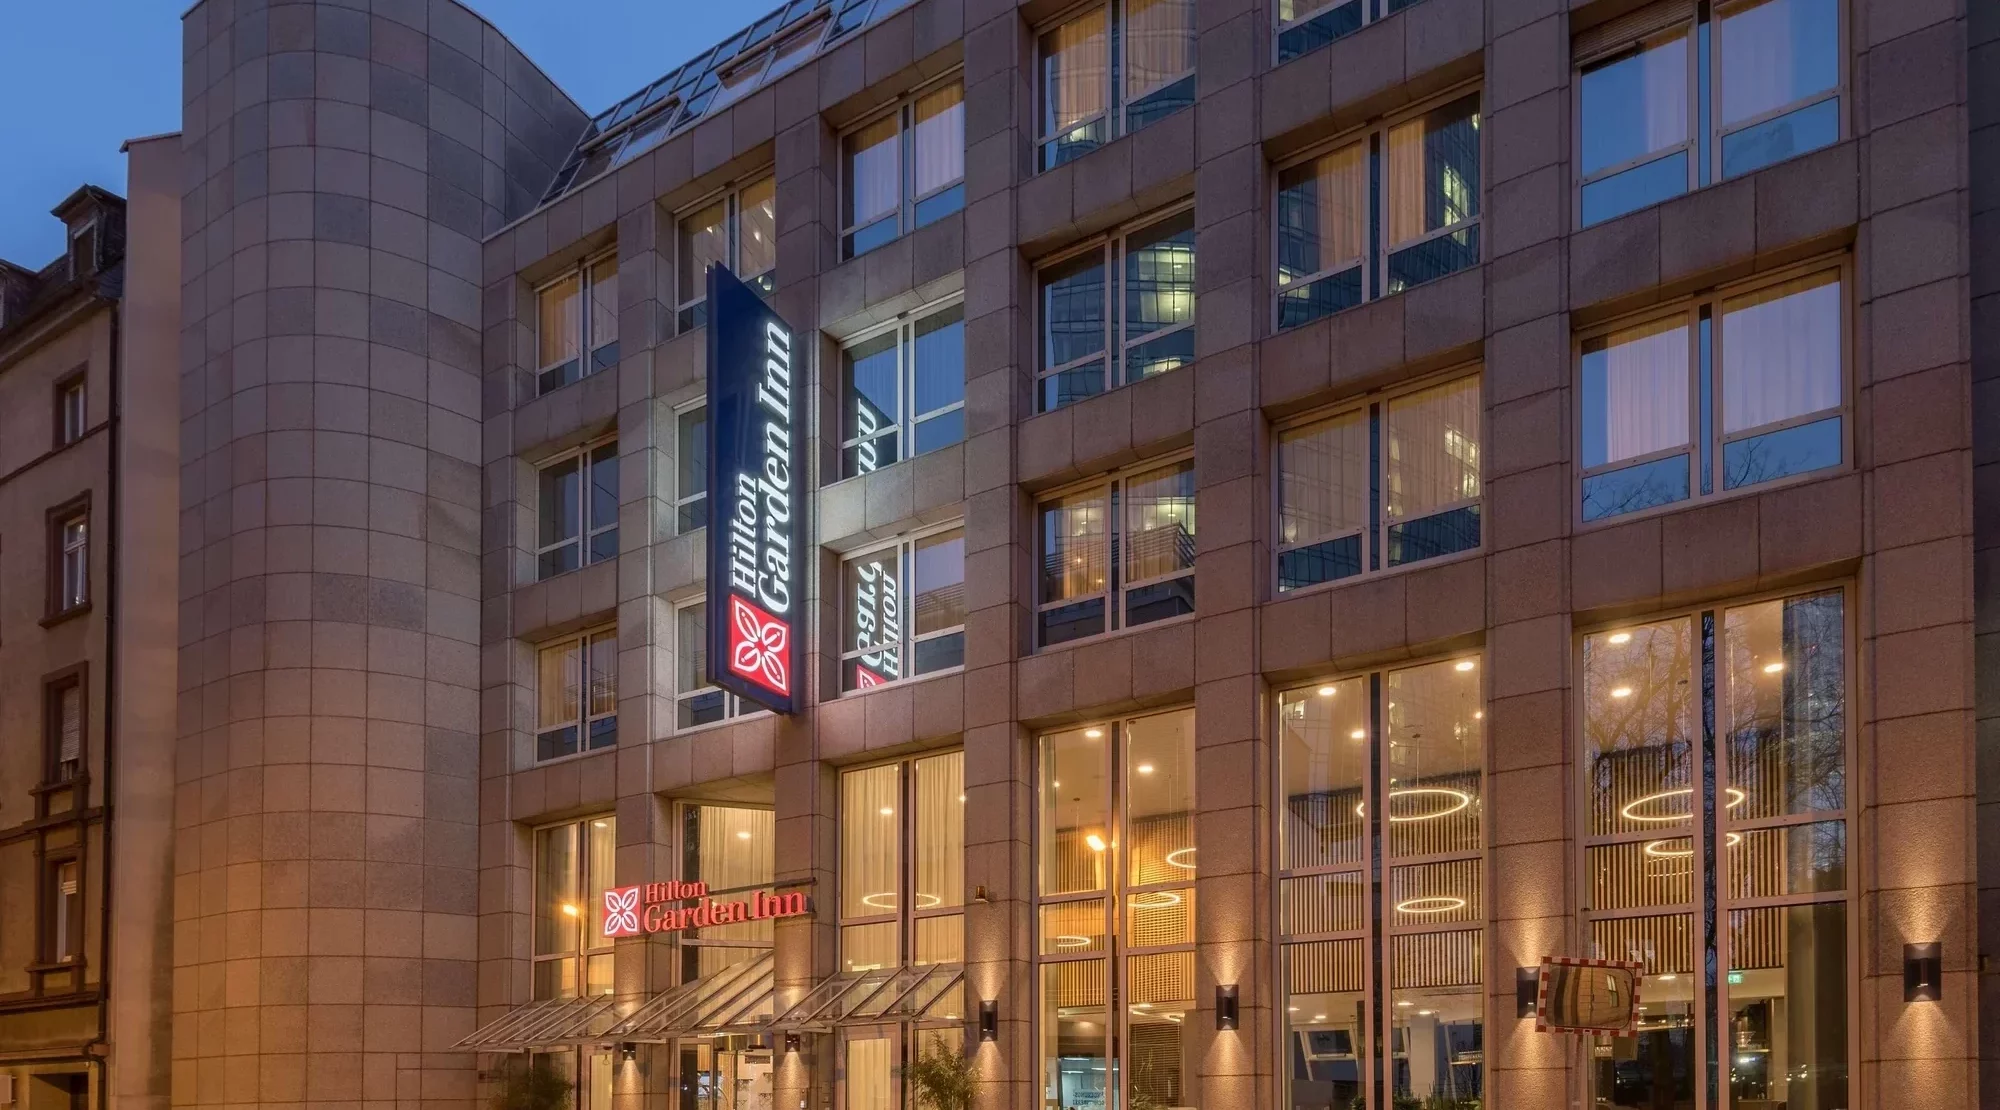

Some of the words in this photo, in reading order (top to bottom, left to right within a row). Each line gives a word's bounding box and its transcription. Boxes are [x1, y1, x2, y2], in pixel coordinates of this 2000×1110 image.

[758, 321, 790, 424] Inn
[732, 472, 757, 599] Hilton
[757, 421, 790, 613] Garden
[643, 897, 748, 933] Garden
[751, 889, 808, 920] Inn
[644, 879, 709, 904] Hilton
